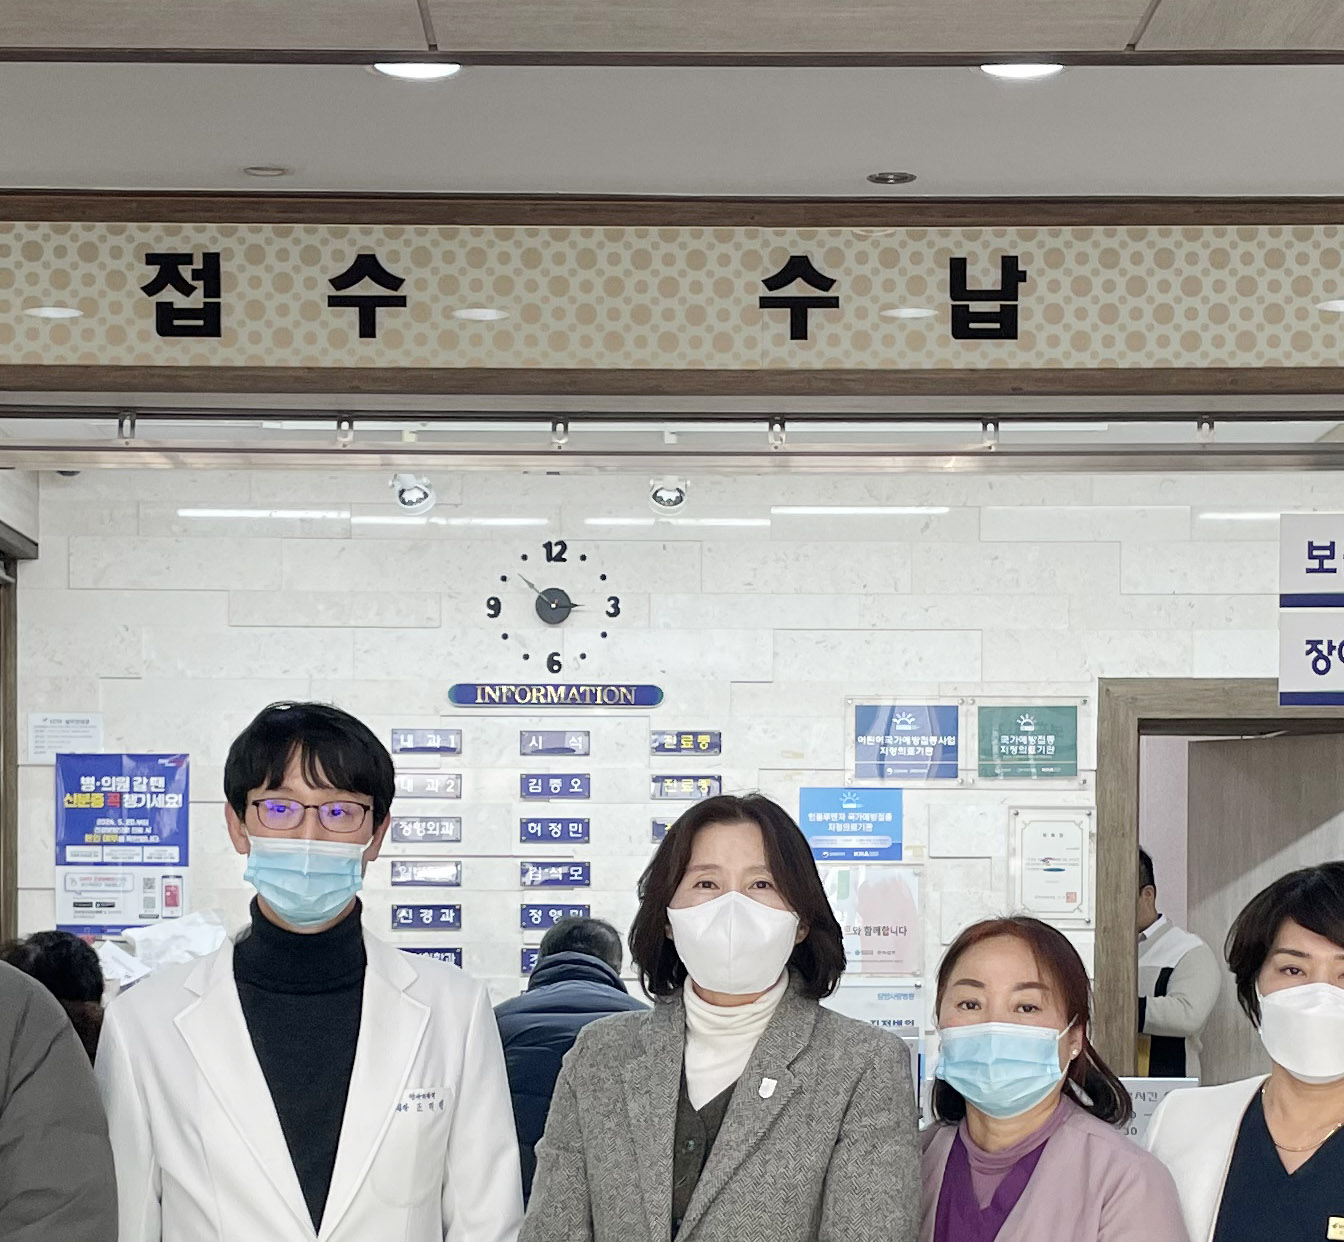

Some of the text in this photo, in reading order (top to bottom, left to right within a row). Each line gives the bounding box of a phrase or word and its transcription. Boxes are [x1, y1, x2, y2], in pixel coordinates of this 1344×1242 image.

[542, 540, 568, 562] 12
[486, 596, 502, 618] 9
[605, 596, 621, 618] 3
[546, 652, 562, 674] 6
[474, 684, 638, 706] INFORMATION
